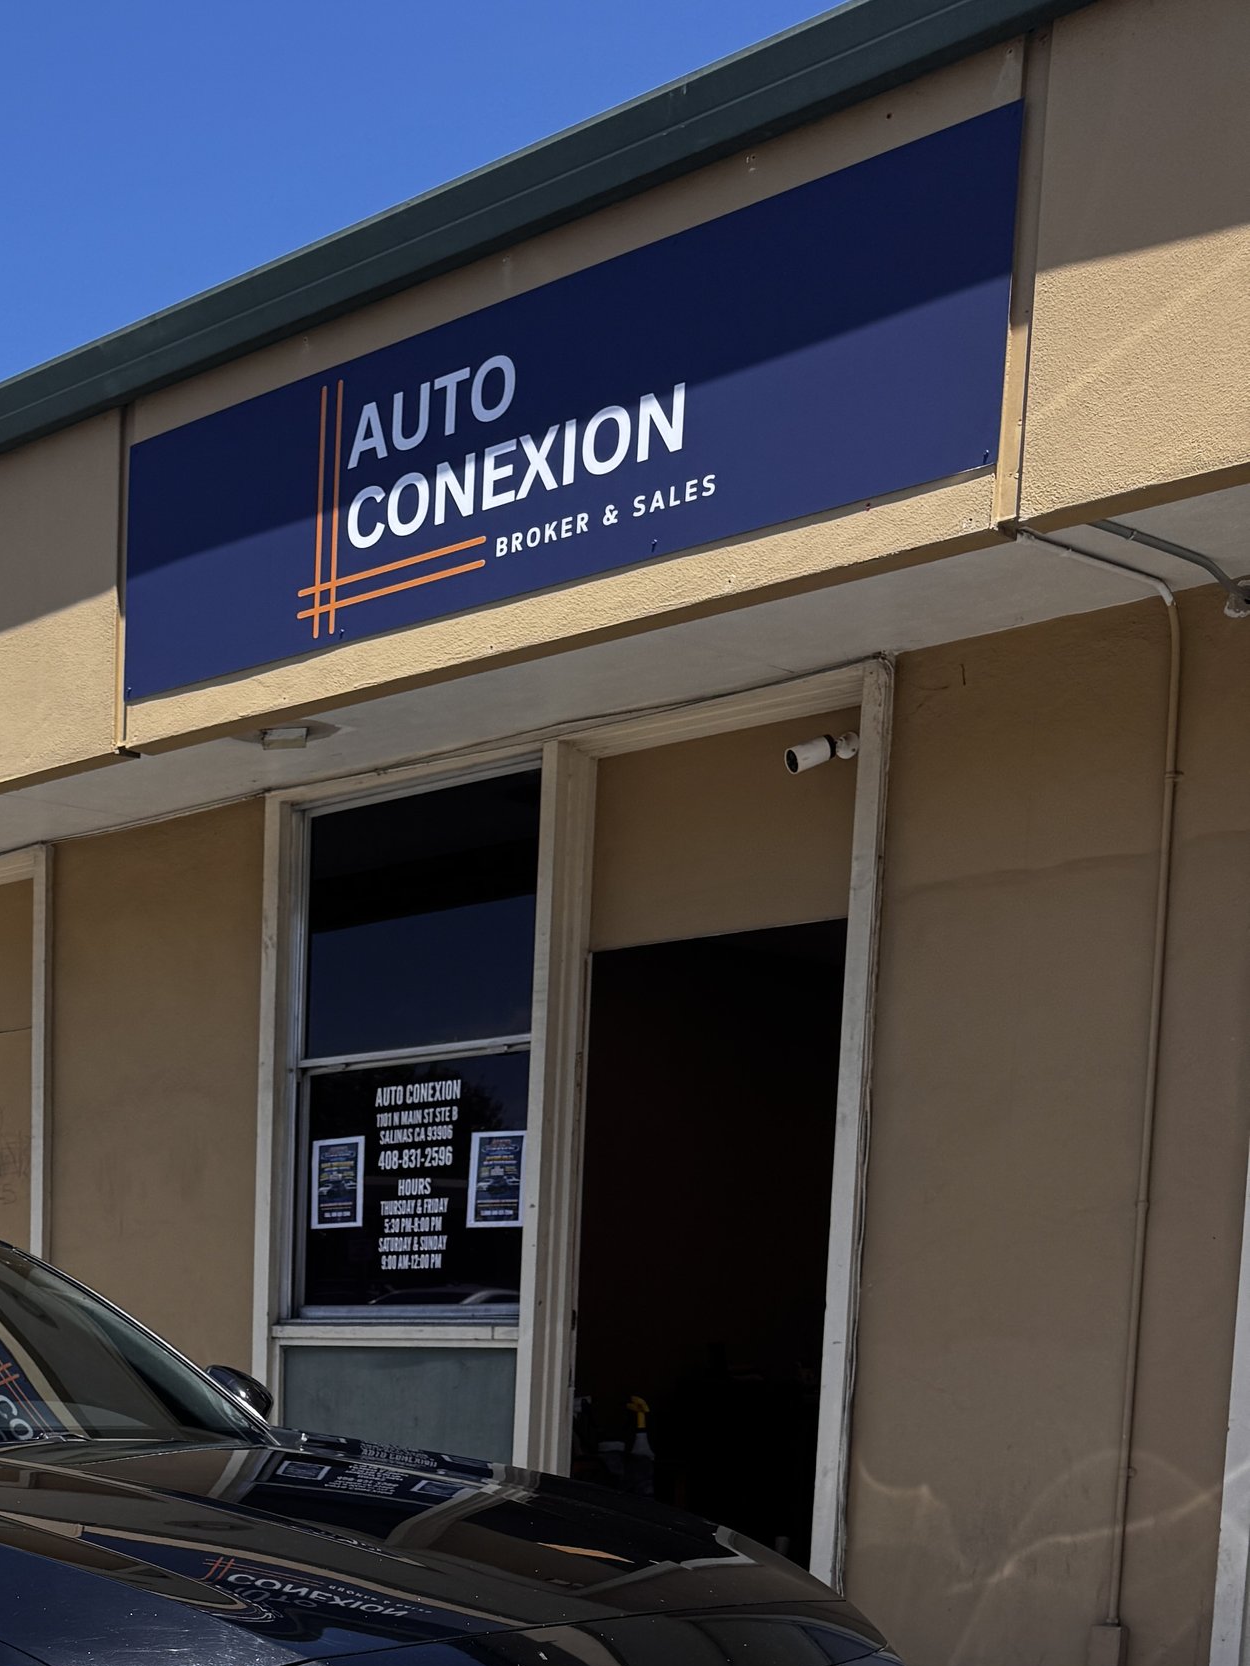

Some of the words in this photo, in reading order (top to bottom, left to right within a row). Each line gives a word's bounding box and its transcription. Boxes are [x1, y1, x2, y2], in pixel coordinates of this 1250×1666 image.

[347, 354, 516, 470] AUTO
[347, 382, 687, 549] CONEXION
[496, 512, 588, 558] BROKER
[602, 504, 619, 525] &
[632, 474, 717, 518] SALES
[375, 1085, 403, 1107] AUTO
[406, 1079, 461, 1104] CONEXION
[393, 1111, 400, 1126] N
[401, 1109, 422, 1125] MAIN
[423, 1108, 434, 1123] ST
[435, 1107, 451, 1122] STE
[452, 1106, 458, 1121] B
[379, 1128, 413, 1145] SALINAS
[414, 1127, 425, 1142] CA
[427, 1124, 453, 1141] 93906
[378, 1146, 453, 1170] 408-831-2596
[398, 1178, 431, 1196] HOURS
[380, 1199, 416, 1216] THURSDAY
[416, 1199, 422, 1214] &
[423, 1197, 449, 1213] FRIDAY
[384, 1218, 400, 1233] 5:30
[431, 1216, 442, 1231] PM
[378, 1237, 412, 1253] SATURDAY
[412, 1236, 419, 1251] &
[420, 1235, 448, 1251] SUNDAY
[381, 1254, 397, 1270] 9:00
[430, 1253, 442, 1269] PM
